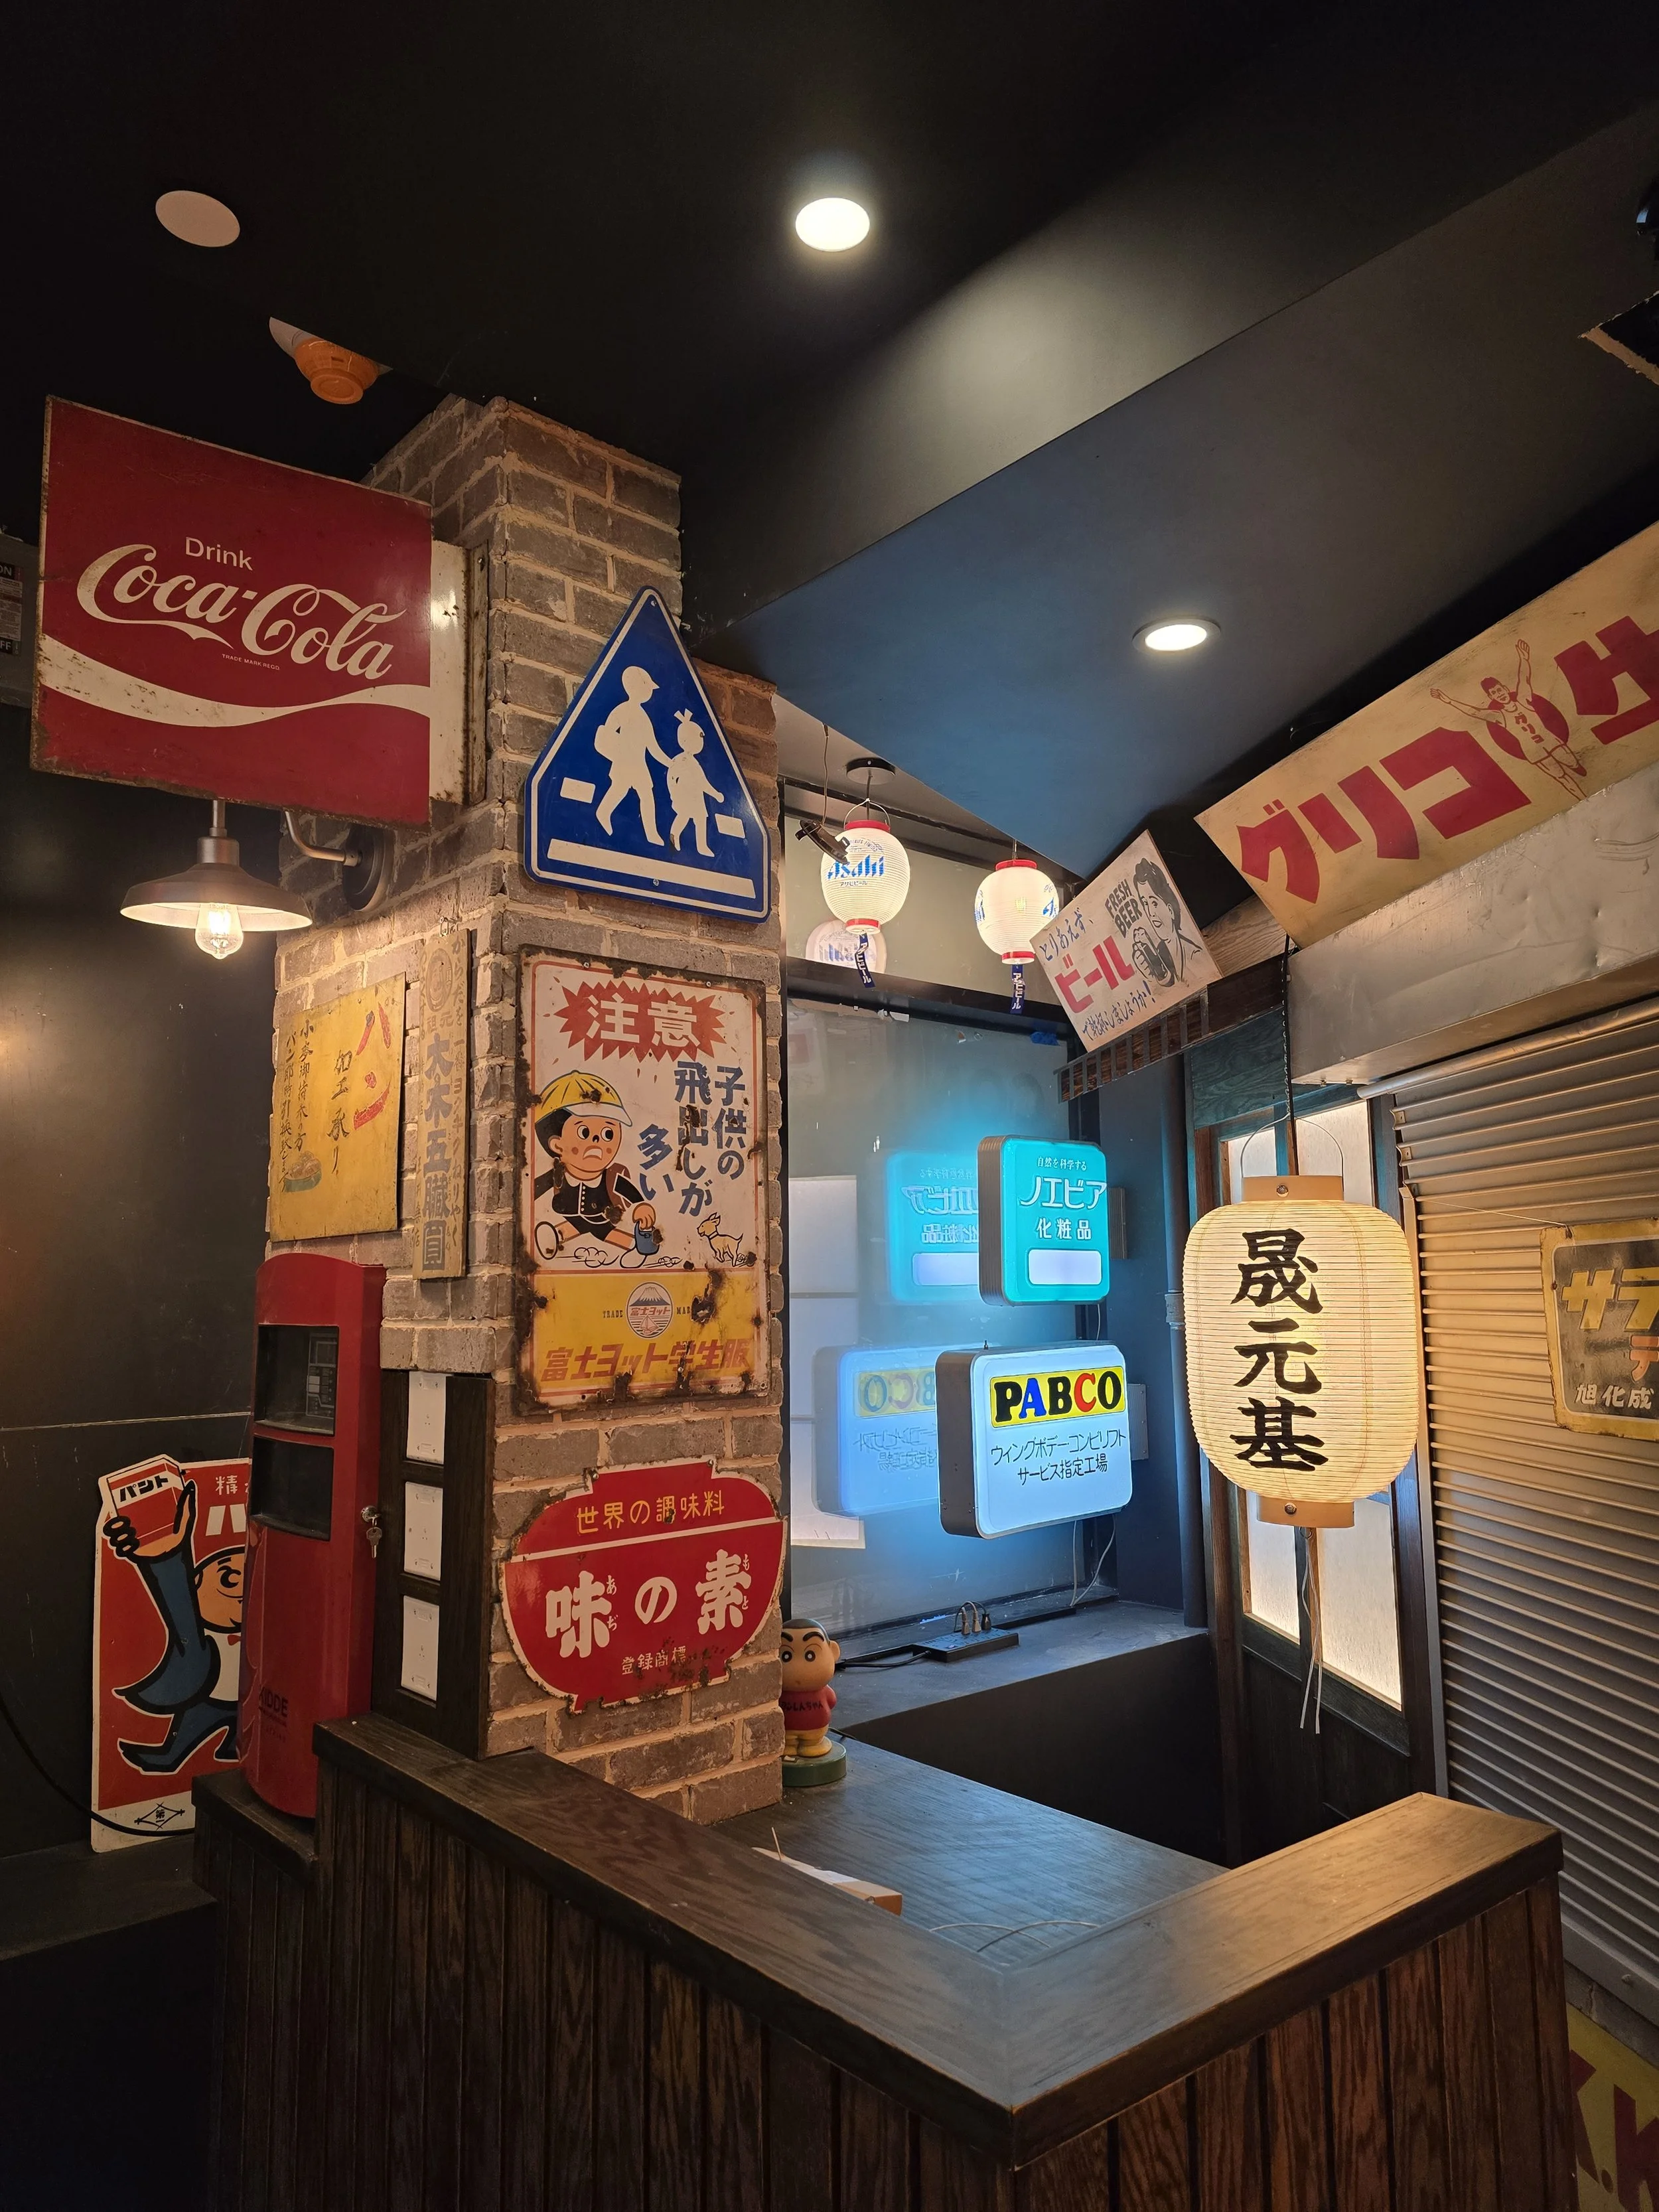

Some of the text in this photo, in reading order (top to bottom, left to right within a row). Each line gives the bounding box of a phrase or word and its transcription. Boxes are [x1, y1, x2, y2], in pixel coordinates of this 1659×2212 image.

[184, 536, 253, 571] Drink
[76, 544, 407, 680] Coca-Cola
[0, 640, 11, 650] FF
[222, 653, 242, 662] TRADE
[244, 658, 262, 667] MARK
[1514, 711, 1545, 744] グリコ
[1236, 727, 1532, 904] グリコ
[826, 855, 885, 880] Asahi
[1104, 878, 1133, 919] FRESH
[1114, 897, 1143, 938] BEER
[1054, 935, 1136, 1014] ビール
[586, 993, 701, 1049] 注意
[674, 1060, 713, 1217] 飛出しが
[711, 1065, 747, 1181] 子供の
[638, 1123, 676, 1201] 多い
[1037, 1155, 1088, 1171] 自然を科学する
[1019, 1176, 1108, 1210] ノエビア
[1036, 1217, 1092, 1240] 化粧品
[603, 1305, 692, 1319] TRADE MAR
[630, 1306, 671, 1316] 富士ヨット
[1229, 1227, 1329, 1472] 晟元基
[993, 1370, 1122, 1423] PABCO
[1575, 1384, 1654, 1410] 旭化成
[1017, 1453, 1108, 1486] サービス指定工場
[576, 1489, 725, 1534] 世界の調味料
[545, 1548, 752, 1659] 味の素
[621, 1645, 687, 1675] 登録商標
